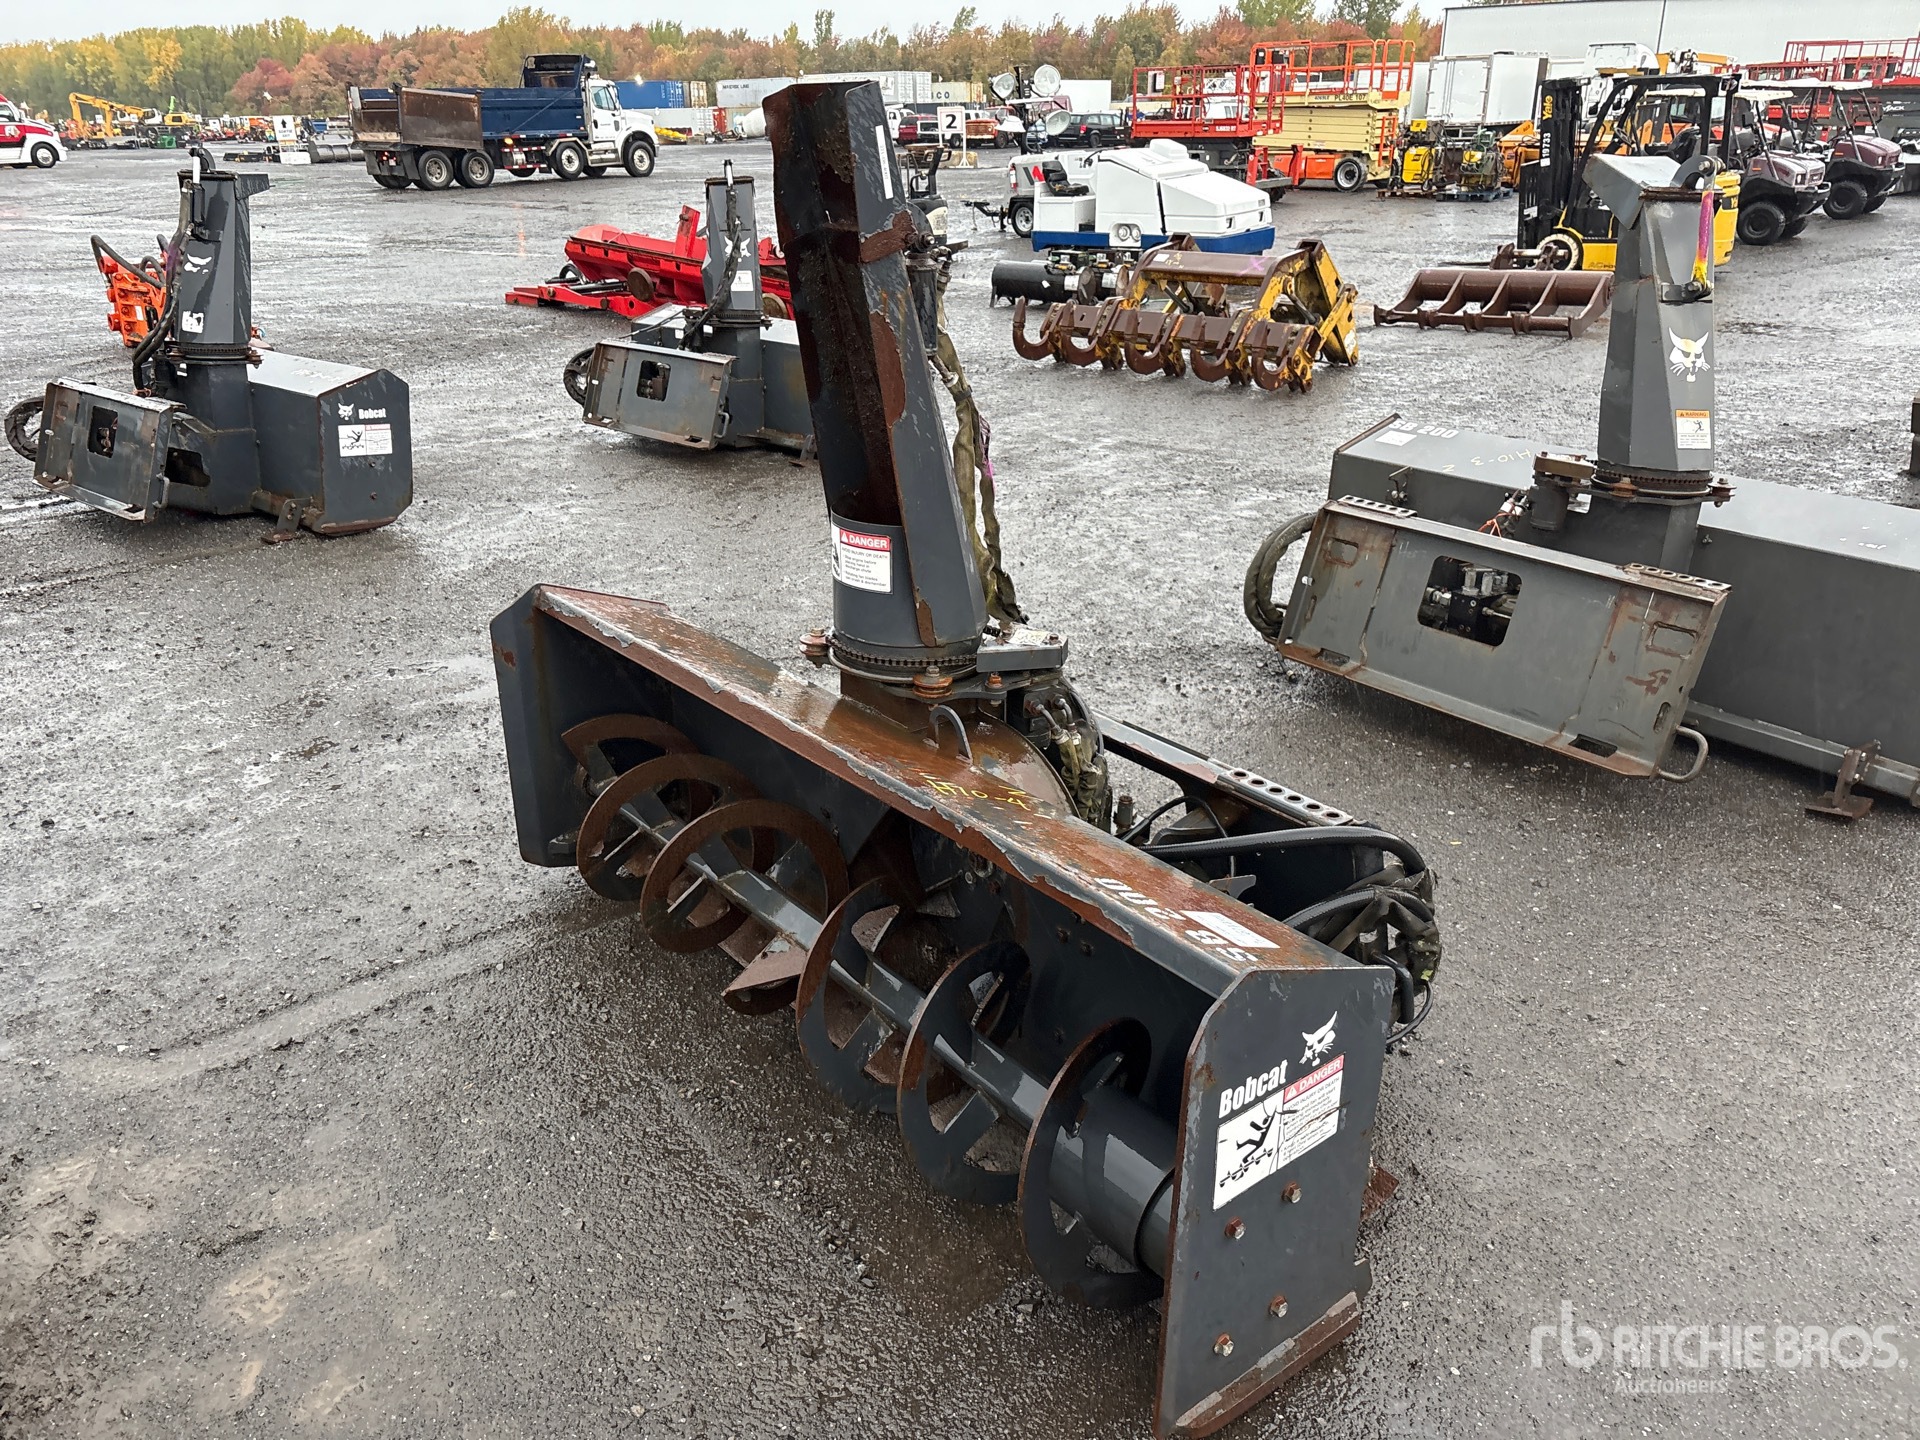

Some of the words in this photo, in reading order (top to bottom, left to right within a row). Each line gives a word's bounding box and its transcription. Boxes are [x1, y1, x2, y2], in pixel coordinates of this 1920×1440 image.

[945, 114, 958, 129] 2
[358, 408, 386, 420] Bobcat
[1389, 420, 1418, 432] SB
[1417, 425, 1459, 438] 200
[849, 534, 888, 548] DANGER
[1300, 1060, 1340, 1090] DANGER
[1218, 1059, 1288, 1119] Bobcat
